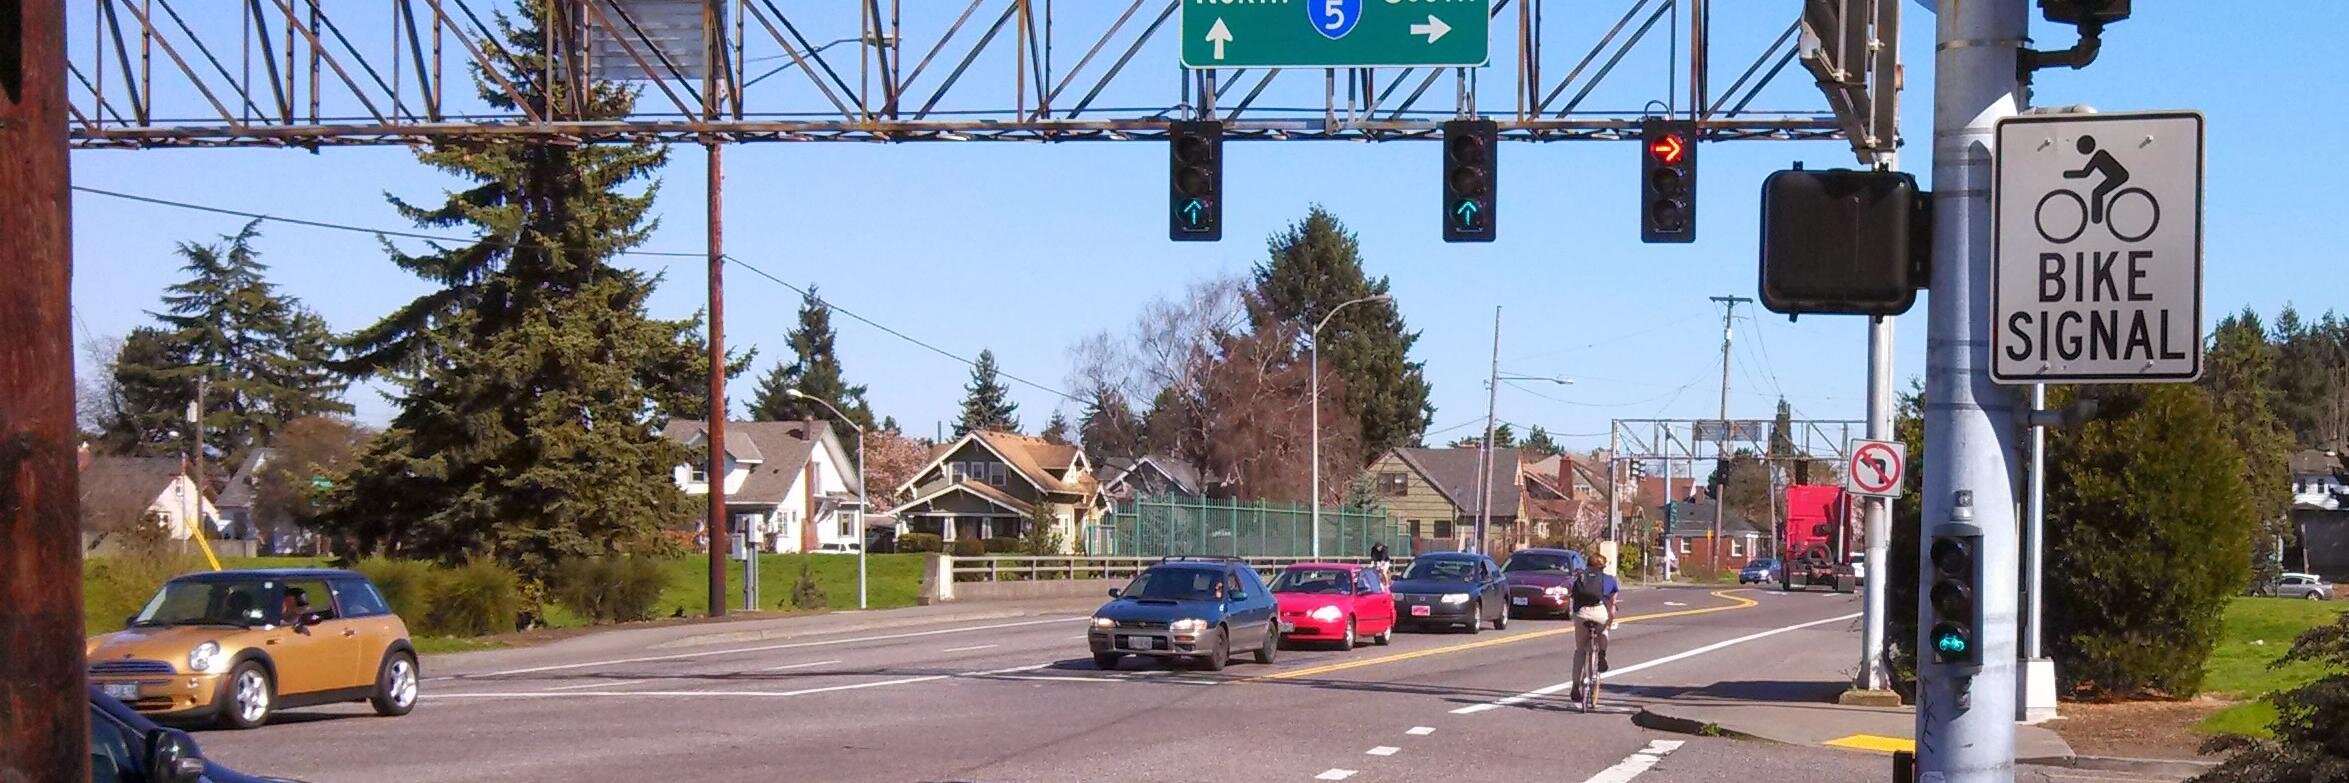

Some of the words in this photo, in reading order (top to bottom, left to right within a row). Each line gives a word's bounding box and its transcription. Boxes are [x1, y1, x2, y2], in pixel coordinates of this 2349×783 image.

[1325, 0, 1345, 30] 5
[2038, 251, 2153, 302] BIKE
[2006, 309, 2186, 361] SIGNAL
